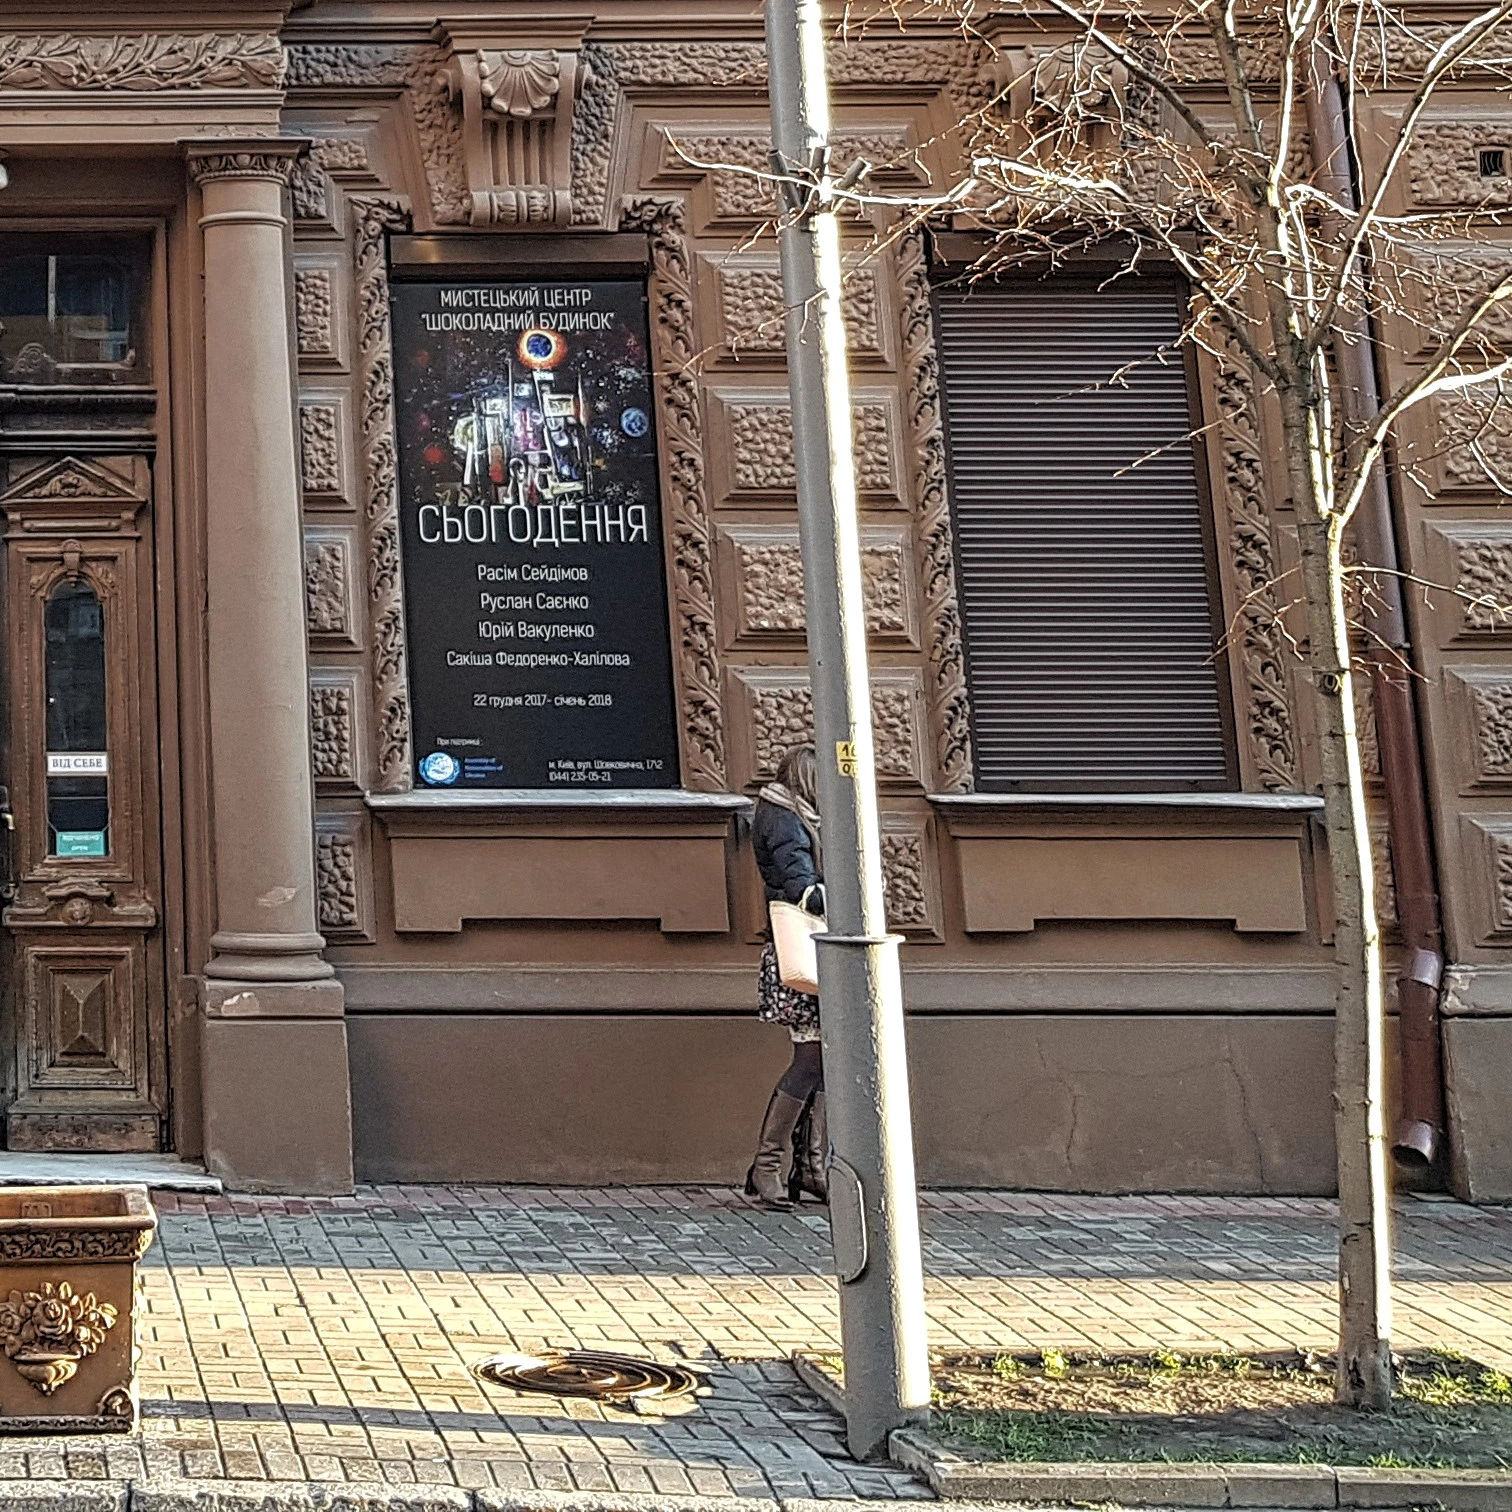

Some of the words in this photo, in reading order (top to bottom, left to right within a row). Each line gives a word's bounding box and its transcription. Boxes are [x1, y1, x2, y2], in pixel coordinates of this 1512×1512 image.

[440, 287, 539, 308] МИСТЕЦЬКИЙ
[544, 289, 592, 308] ЦЕНТР
[418, 505, 648, 548] СЬОГОДЕННЯ
[477, 564, 518, 581] Расім
[521, 564, 589, 583] Сейдімов
[480, 593, 533, 613] Руслан
[536, 592, 589, 609] Саєнко
[478, 621, 515, 640] Юрій
[518, 621, 595, 641] Вакуленко
[446, 651, 492, 666] Сакіша
[496, 651, 631, 668] Федоренко-Халілова
[473, 694, 487, 706] 22
[489, 696, 523, 708] грудня
[554, 694, 586, 706] січень
[588, 694, 612, 706] 2018
[52, 758, 71, 769] ВІД
[73, 758, 103, 768] СЕБЕ
